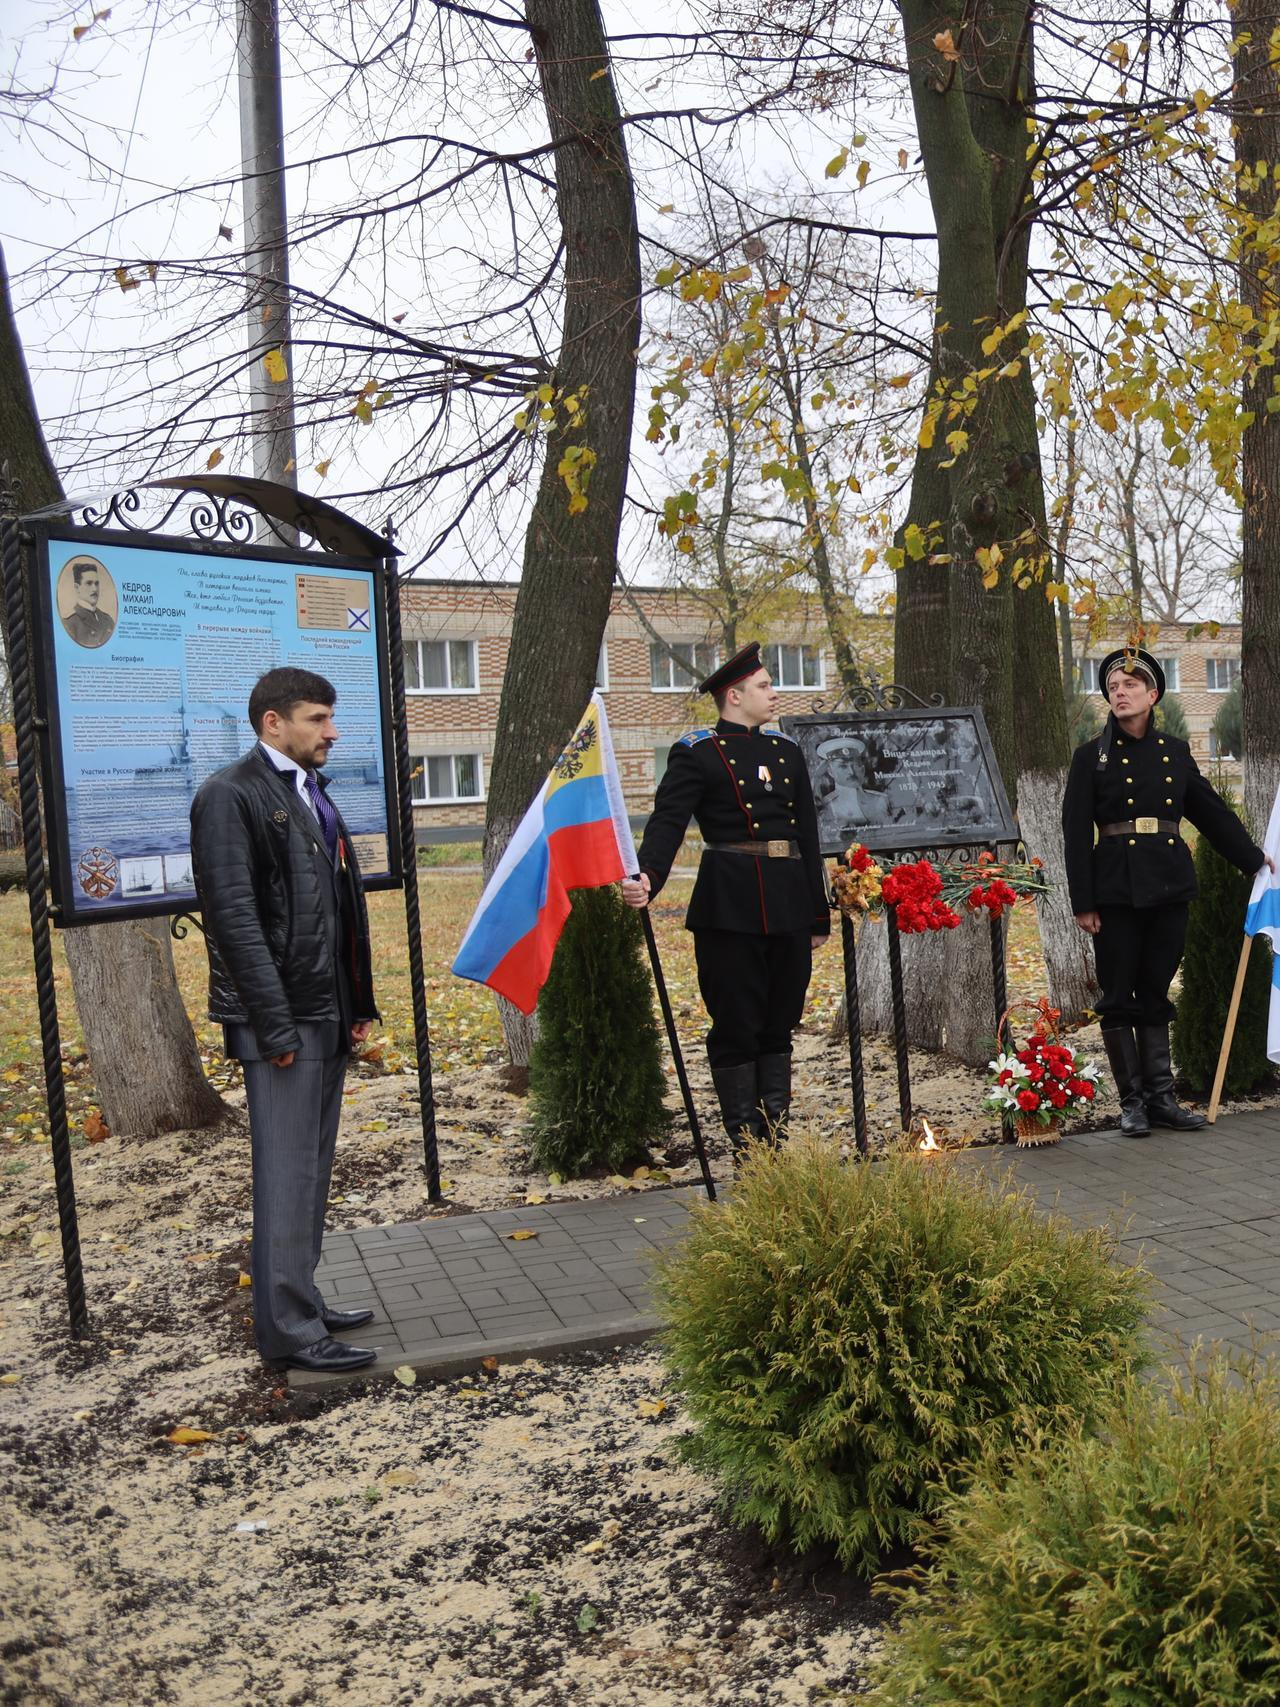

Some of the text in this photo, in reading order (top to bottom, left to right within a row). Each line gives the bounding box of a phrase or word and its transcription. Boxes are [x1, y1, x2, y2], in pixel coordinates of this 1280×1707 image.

[121, 582, 152, 593] КЕДРОВ
[122, 594, 154, 604] МИХАИЛ
[123, 605, 186, 617] АЛЕКСАНДРОВИЧ
[111, 655, 145, 663] Биография
[882, 749, 947, 759] Вице-адмирал
[902, 759, 931, 768] Кедров
[873, 771, 905, 780] Михаил
